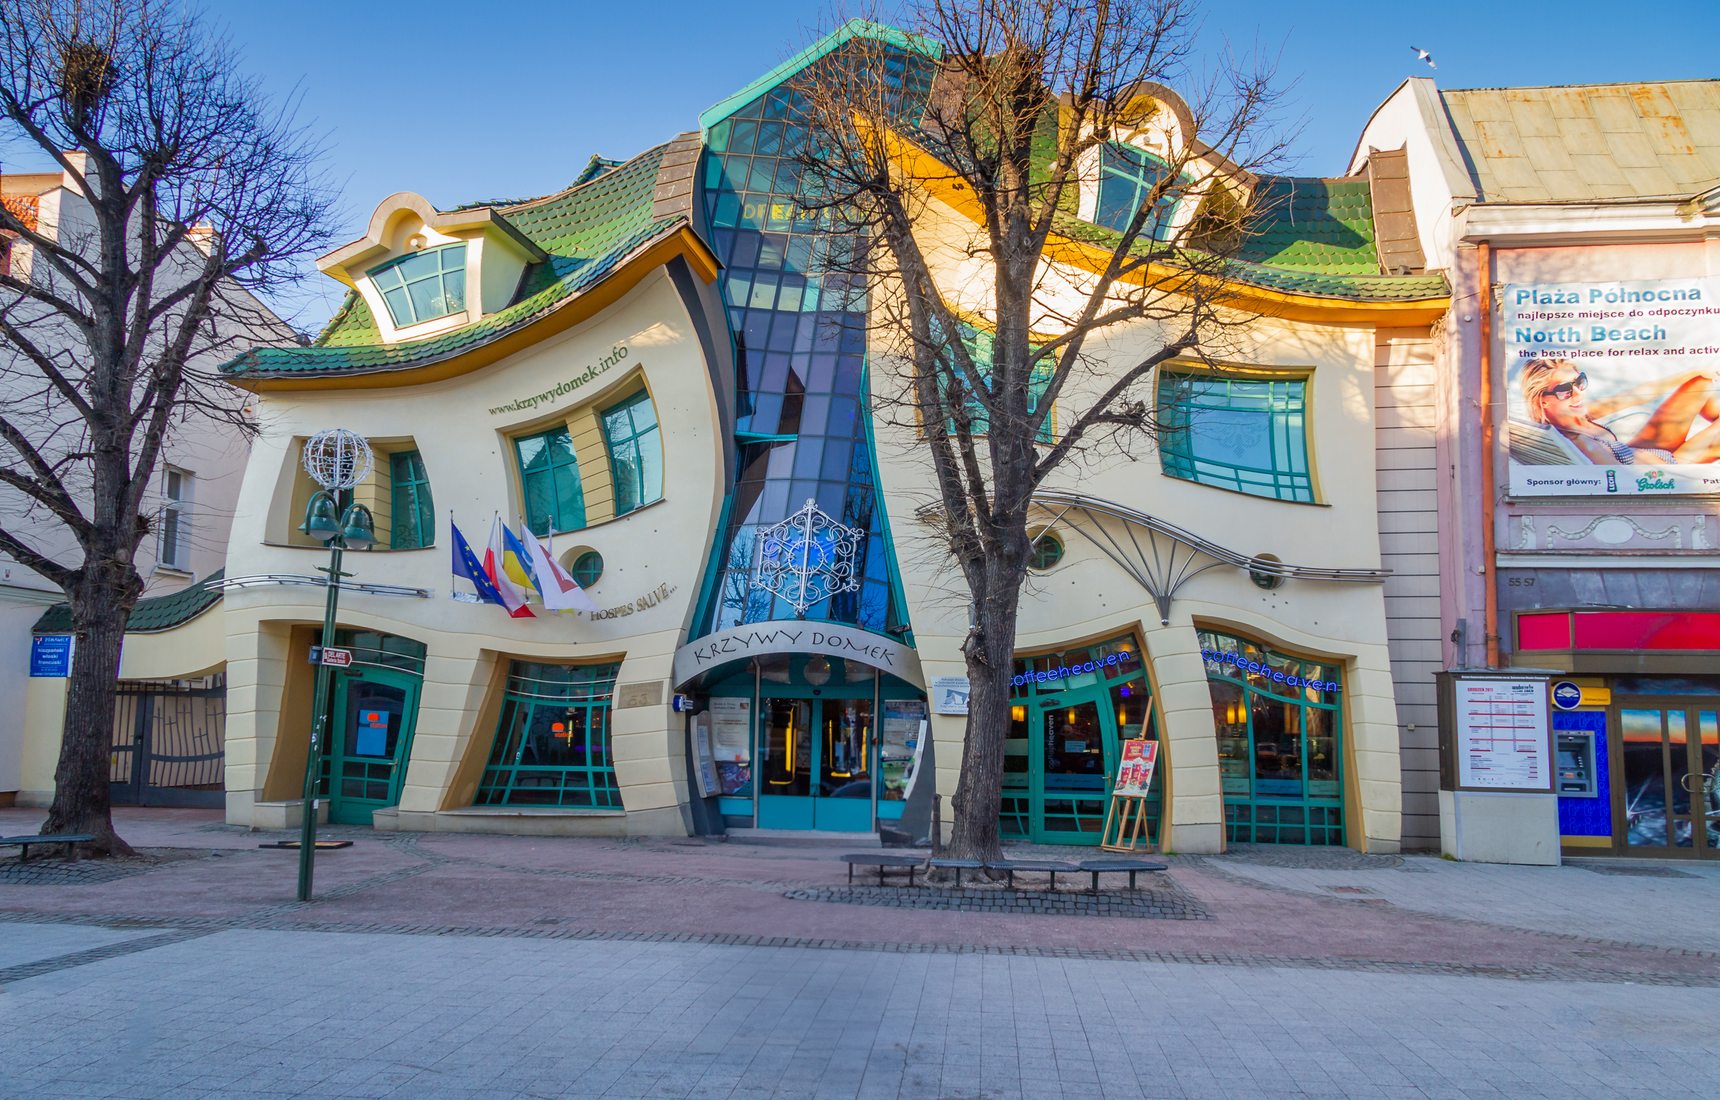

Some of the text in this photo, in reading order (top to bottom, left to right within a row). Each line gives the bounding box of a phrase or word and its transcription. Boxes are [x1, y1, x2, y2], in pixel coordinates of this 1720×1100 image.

[1516, 287, 1702, 305] Plaża Północna
[1517, 306, 1720, 321] najlepsze miejsce do odpoczynku
[1515, 325, 1666, 343] North Beach
[1519, 350, 1537, 358] the
[1541, 349, 1567, 357] best
[1570, 348, 1604, 359] place
[1607, 347, 1625, 357] for
[1628, 347, 1659, 356] relax
[1663, 346, 1686, 355] and
[488, 346, 629, 415] www.krzywydomek.info
[1526, 478, 1564, 486] Sponsor
[591, 602, 634, 621] HOSPES
[694, 630, 895, 666] KRZYWY DOMEK
[1201, 648, 1338, 692] coffeeheaven
